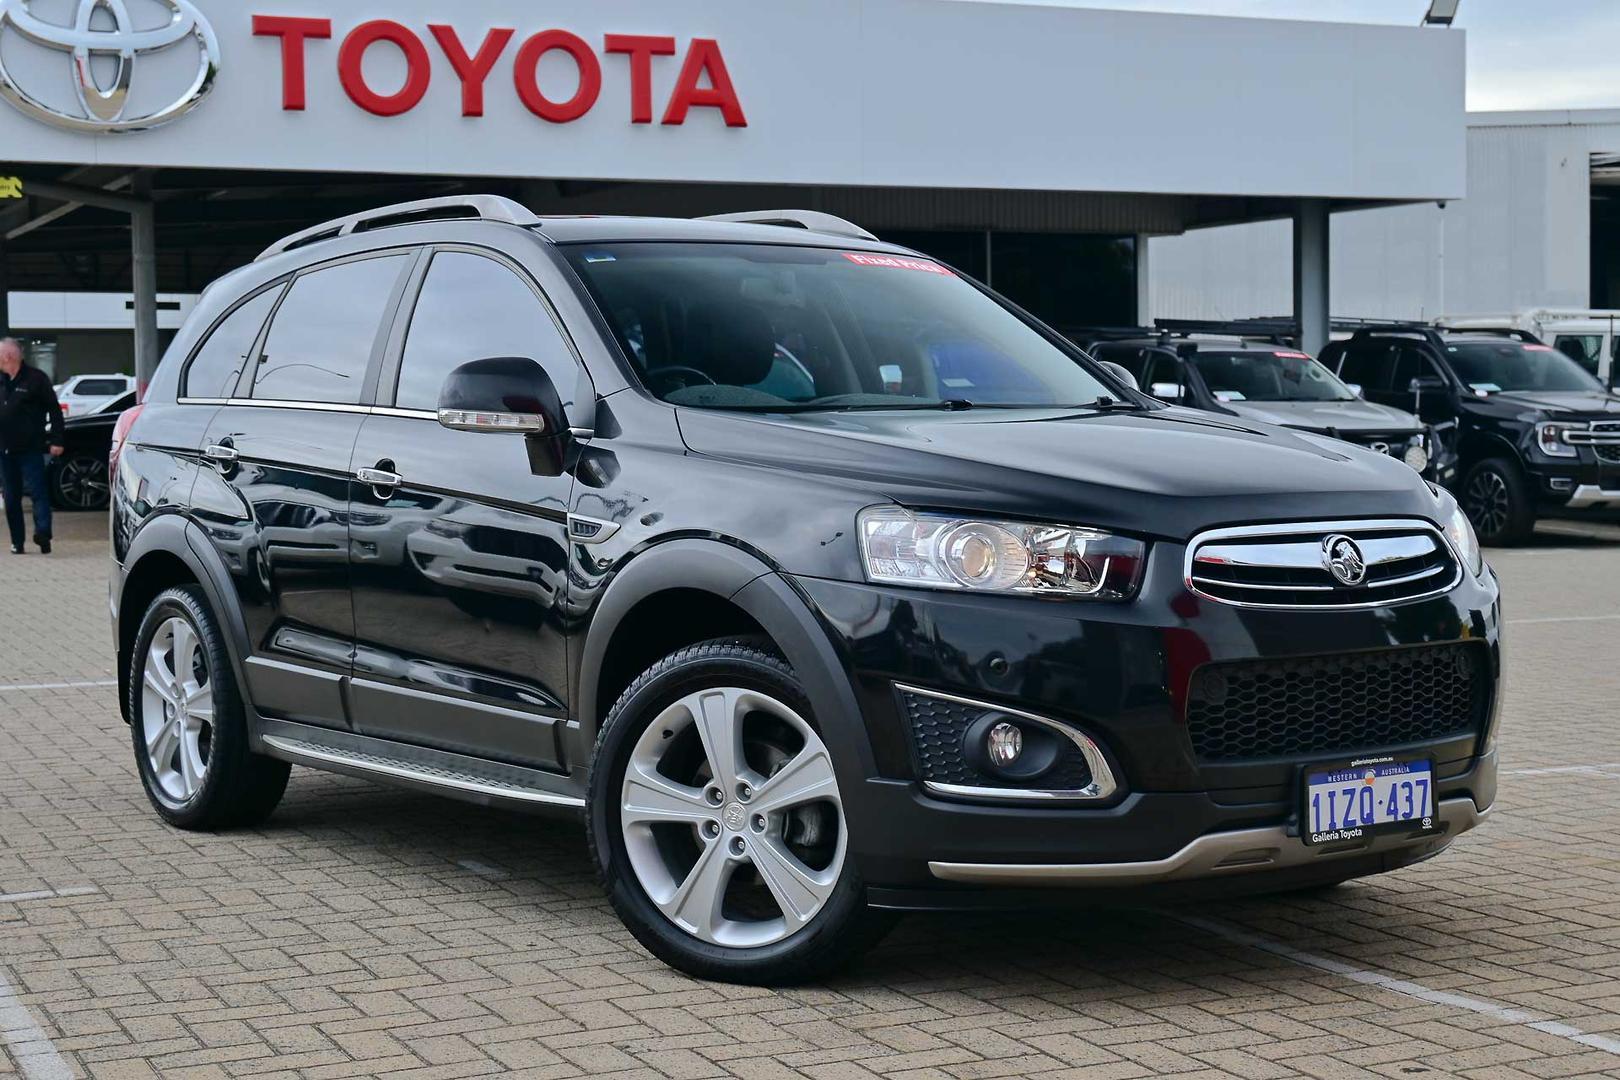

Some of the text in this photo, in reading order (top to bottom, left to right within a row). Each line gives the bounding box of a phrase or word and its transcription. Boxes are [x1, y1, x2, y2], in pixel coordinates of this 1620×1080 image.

[252, 15, 747, 127] TOYOTA
[1327, 766, 1410, 782] WESTERN AUSTRALIA
[1312, 828, 1363, 843] Galleria Toyota
